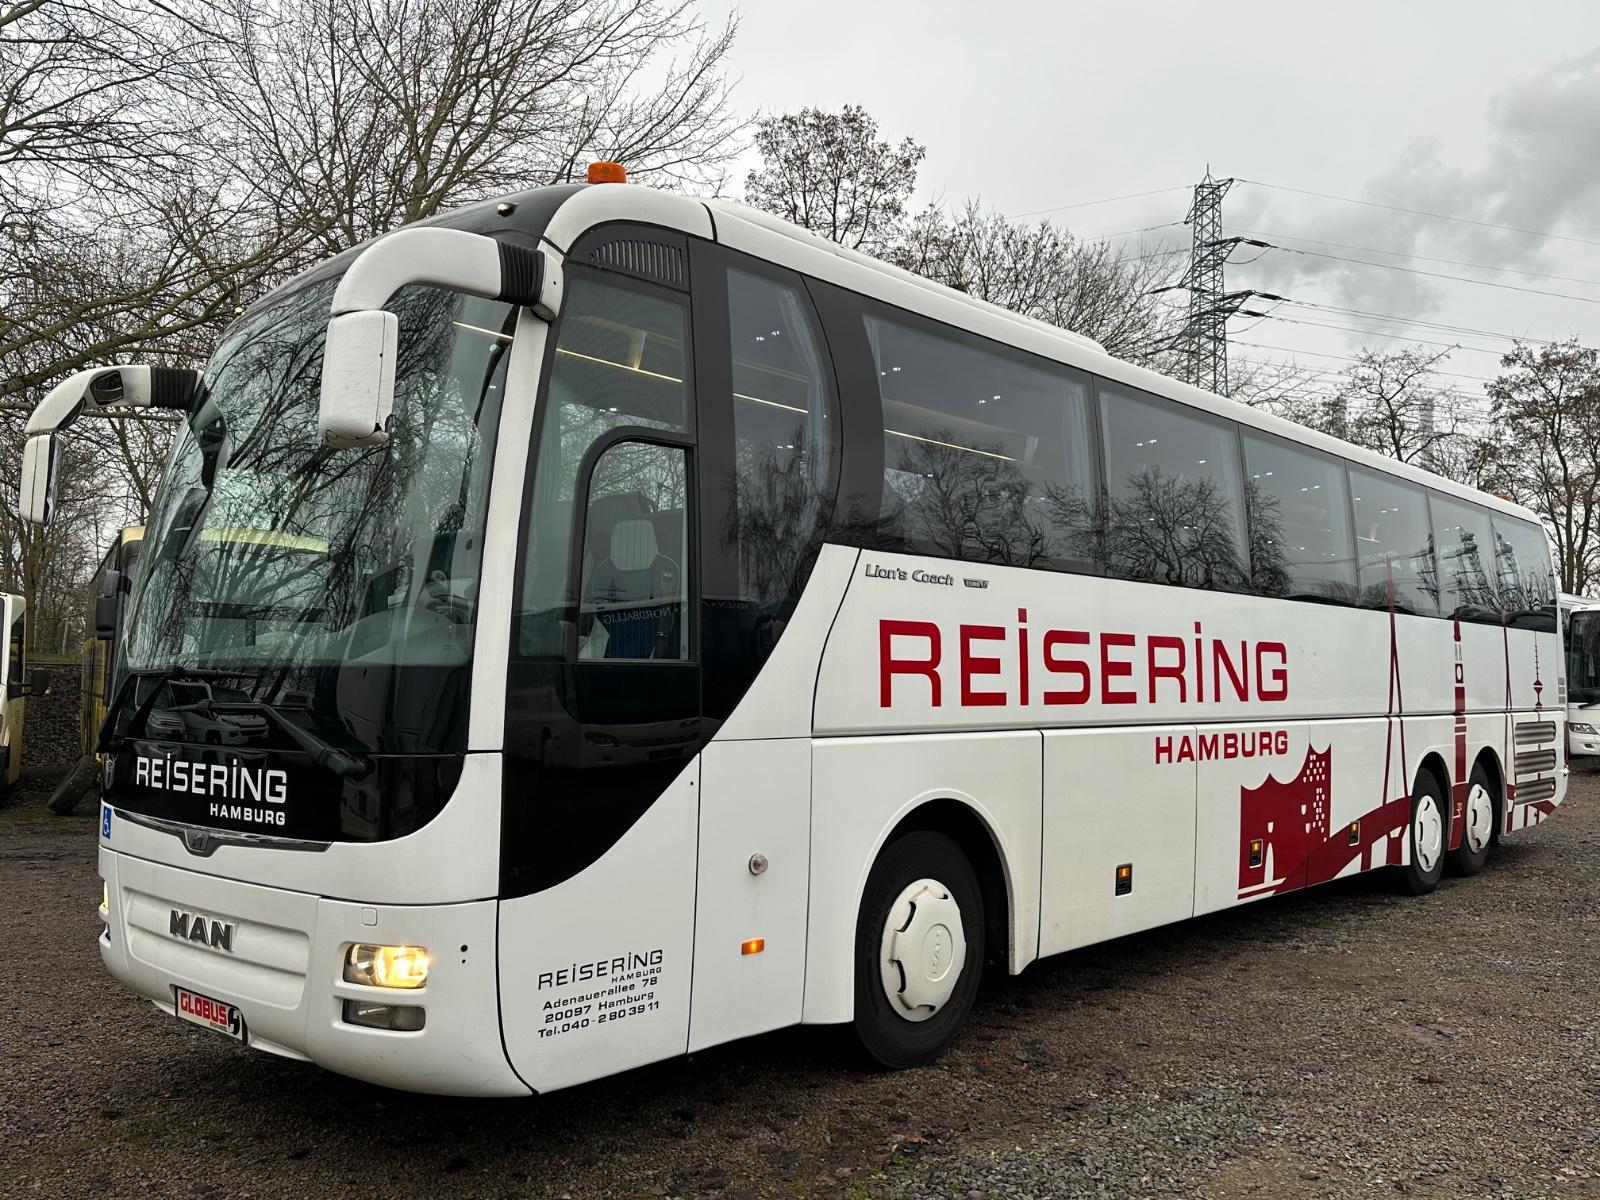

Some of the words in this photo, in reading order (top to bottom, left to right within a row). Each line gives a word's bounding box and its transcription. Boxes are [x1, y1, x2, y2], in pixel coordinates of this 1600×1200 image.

[865, 563, 908, 581] Lion's
[911, 569, 955, 586] Coach
[1155, 730, 1289, 764] HAMBURG
[209, 803, 286, 826] HAMBURG
[169, 909, 236, 952] MAN
[611, 966, 662, 984] HAMBURG
[180, 991, 228, 1026] GLOBUS
[542, 982, 635, 1011] Adenauerallee
[641, 976, 658, 988] 78
[545, 1004, 591, 1024] 20097
[598, 991, 655, 1011] Hamburg
